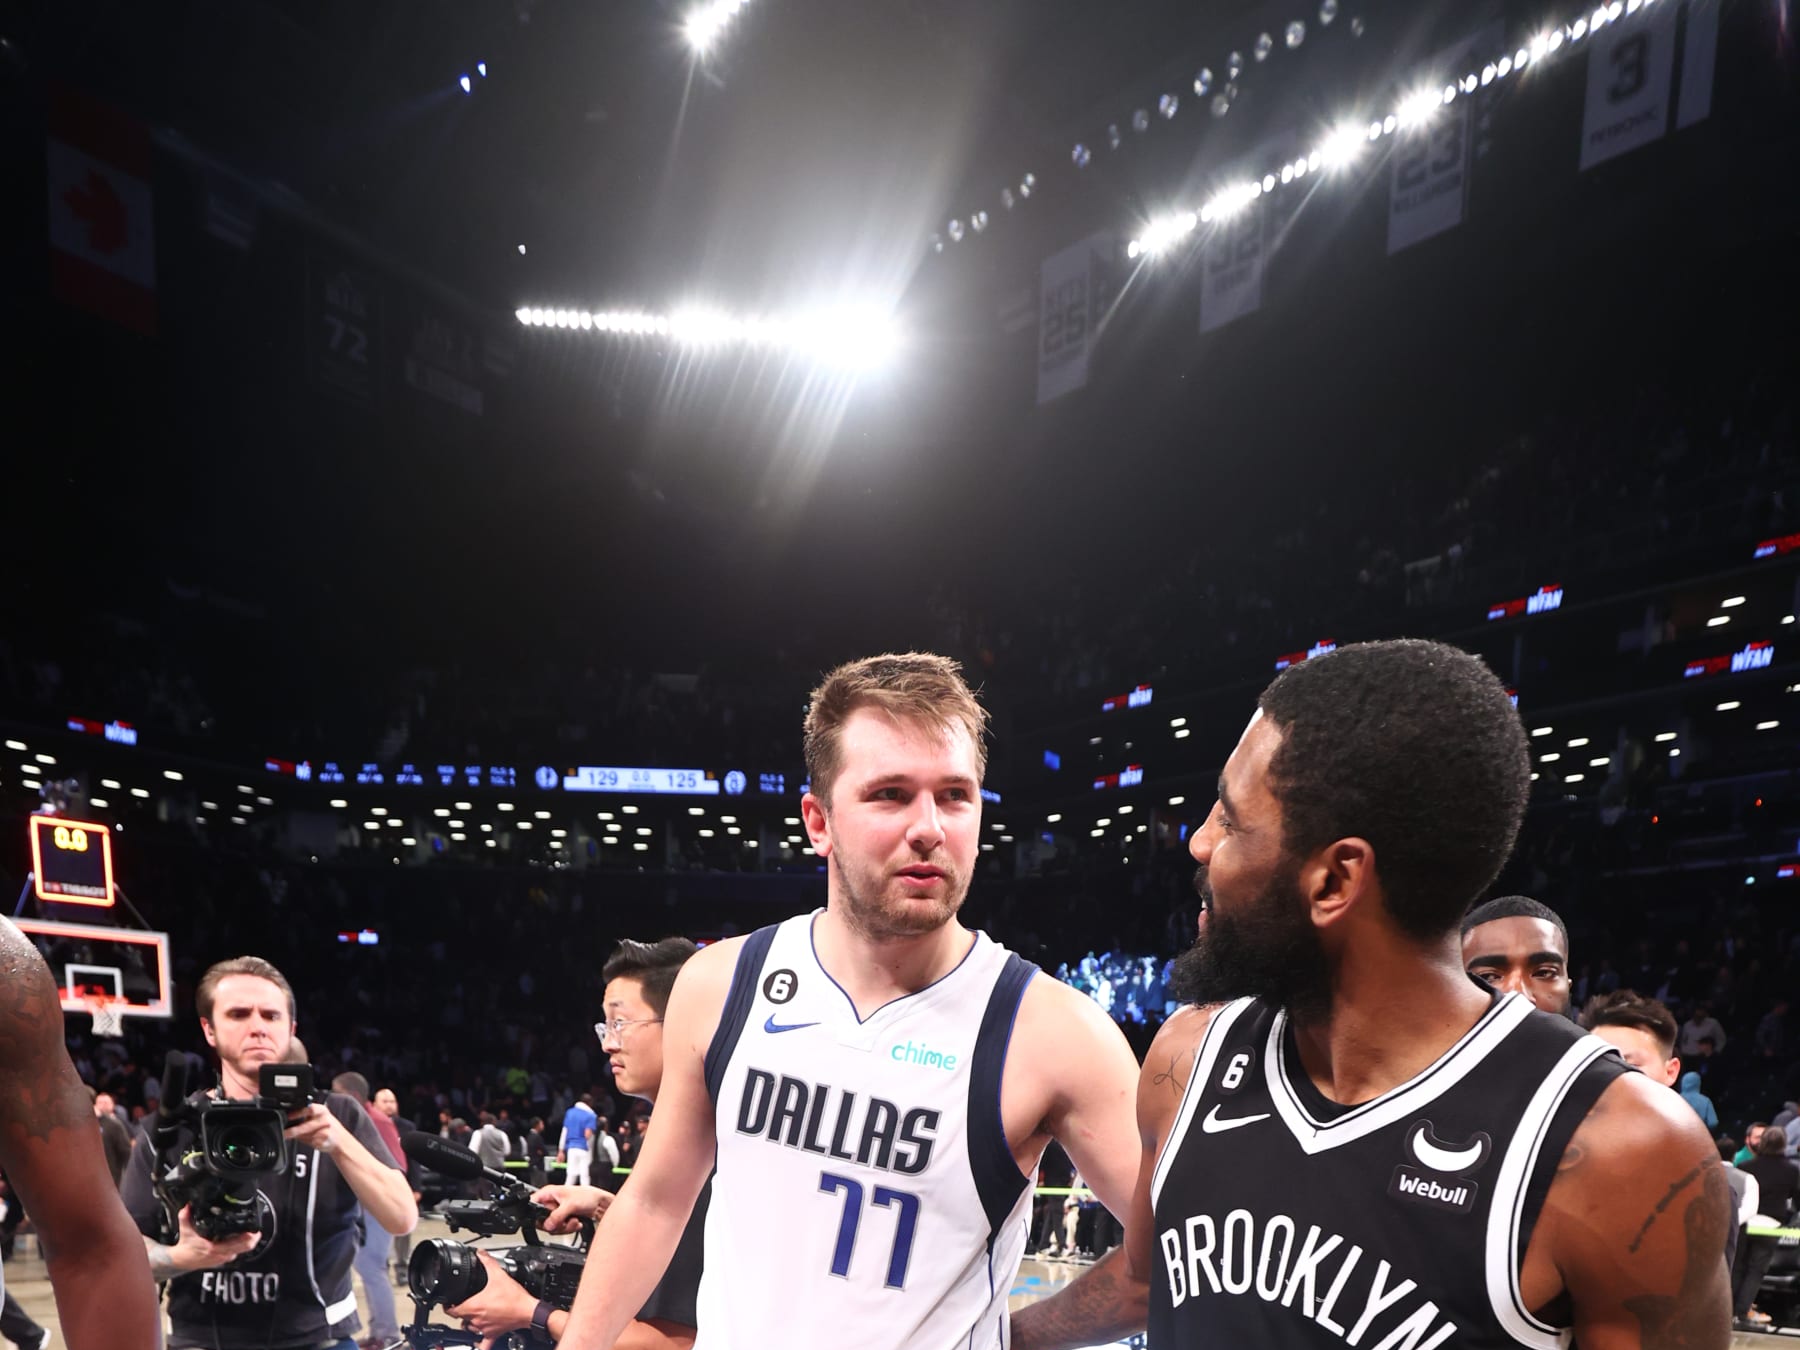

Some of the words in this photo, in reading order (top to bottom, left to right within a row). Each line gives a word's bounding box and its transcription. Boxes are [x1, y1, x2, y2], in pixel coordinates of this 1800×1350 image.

[1608, 29, 1651, 103] 3
[588, 770, 619, 786] 129
[667, 772, 697, 788] 125
[53, 826, 89, 852] 0.0
[768, 972, 793, 1001] 6
[891, 1040, 957, 1071] chime
[1221, 1053, 1251, 1090] 6
[735, 1065, 942, 1176] DALLAS
[1398, 1174, 1468, 1206] Webull
[817, 1170, 922, 1292] 77
